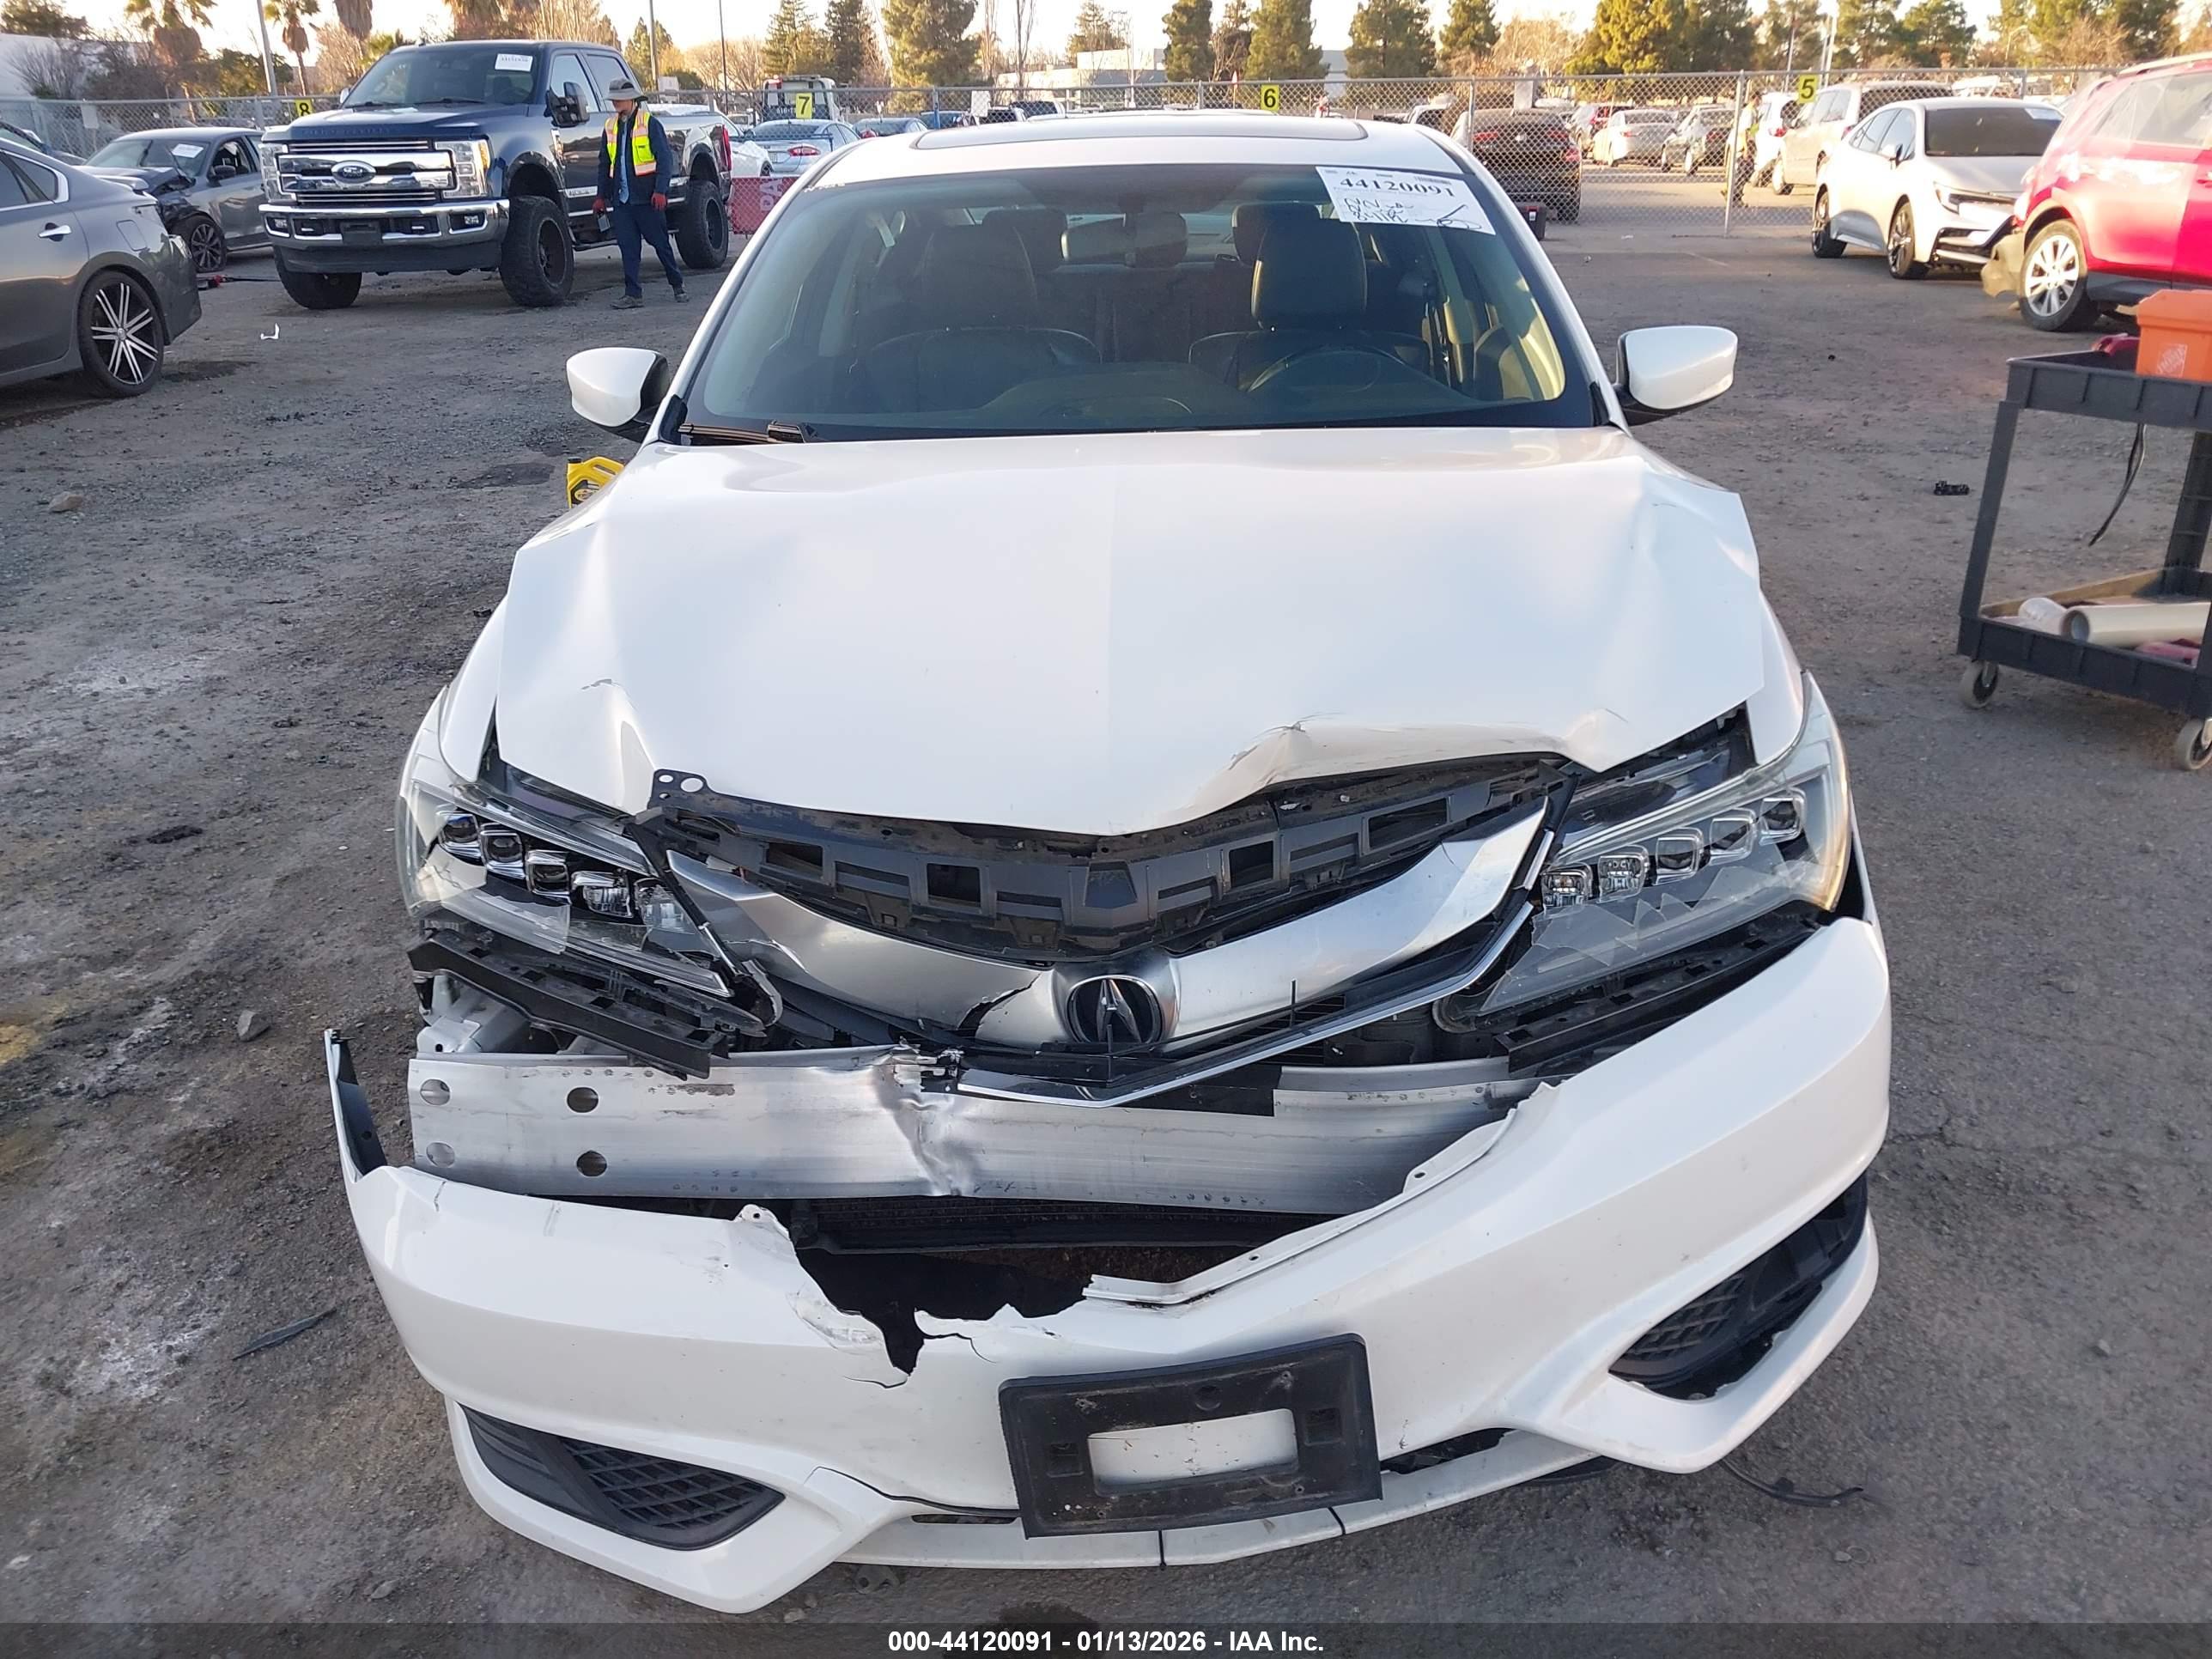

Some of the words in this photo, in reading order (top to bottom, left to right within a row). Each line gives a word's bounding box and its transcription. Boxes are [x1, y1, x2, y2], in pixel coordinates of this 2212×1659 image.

[1263, 88, 1276, 108] 6
[1801, 78, 1814, 99] 5
[799, 95, 810, 115] 7
[1340, 178, 1455, 197] 44120091
